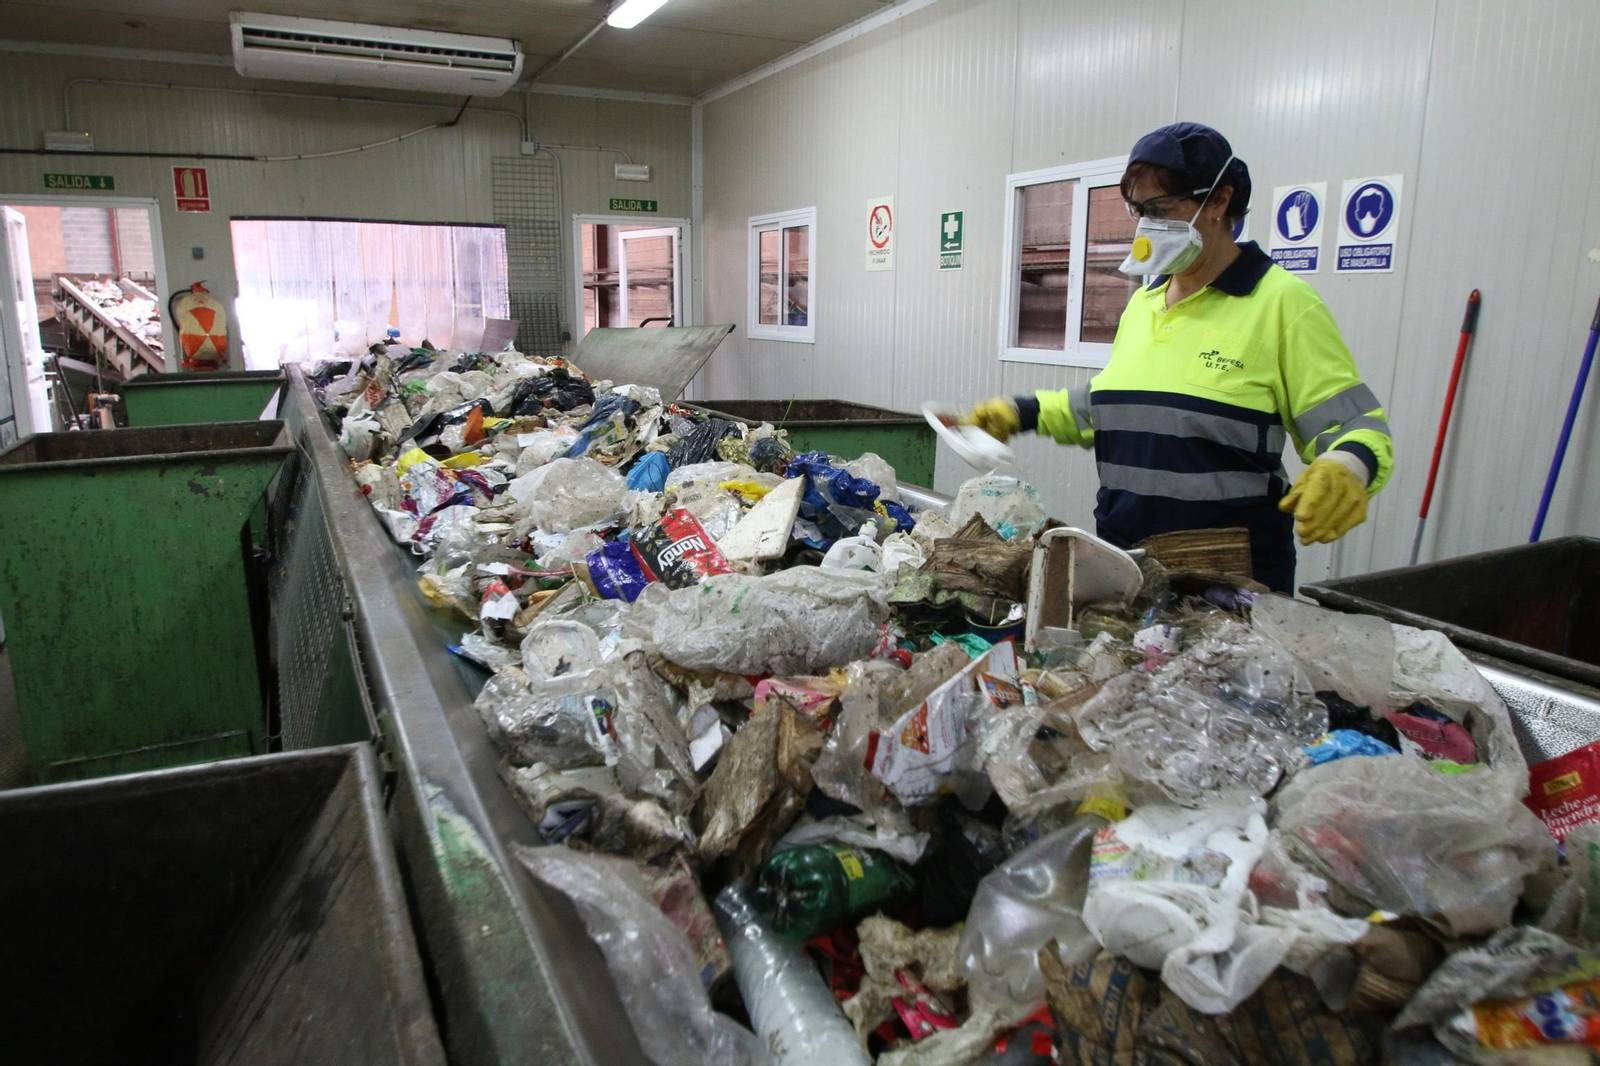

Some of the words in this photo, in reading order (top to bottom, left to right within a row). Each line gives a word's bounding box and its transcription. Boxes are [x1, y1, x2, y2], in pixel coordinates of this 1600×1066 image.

[48, 175, 92, 188] SALIDA
[612, 200, 642, 211] SALIDA
[1283, 248, 1317, 259] OBLIGATORIO
[1339, 248, 1352, 257] USO
[1352, 246, 1391, 257] OBLIGATORIO
[1341, 258, 1350, 267] DE
[1350, 257, 1387, 267] MASCARILLA
[1217, 357, 1244, 369] BEFESA
[1540, 799, 1581, 818] Leche
